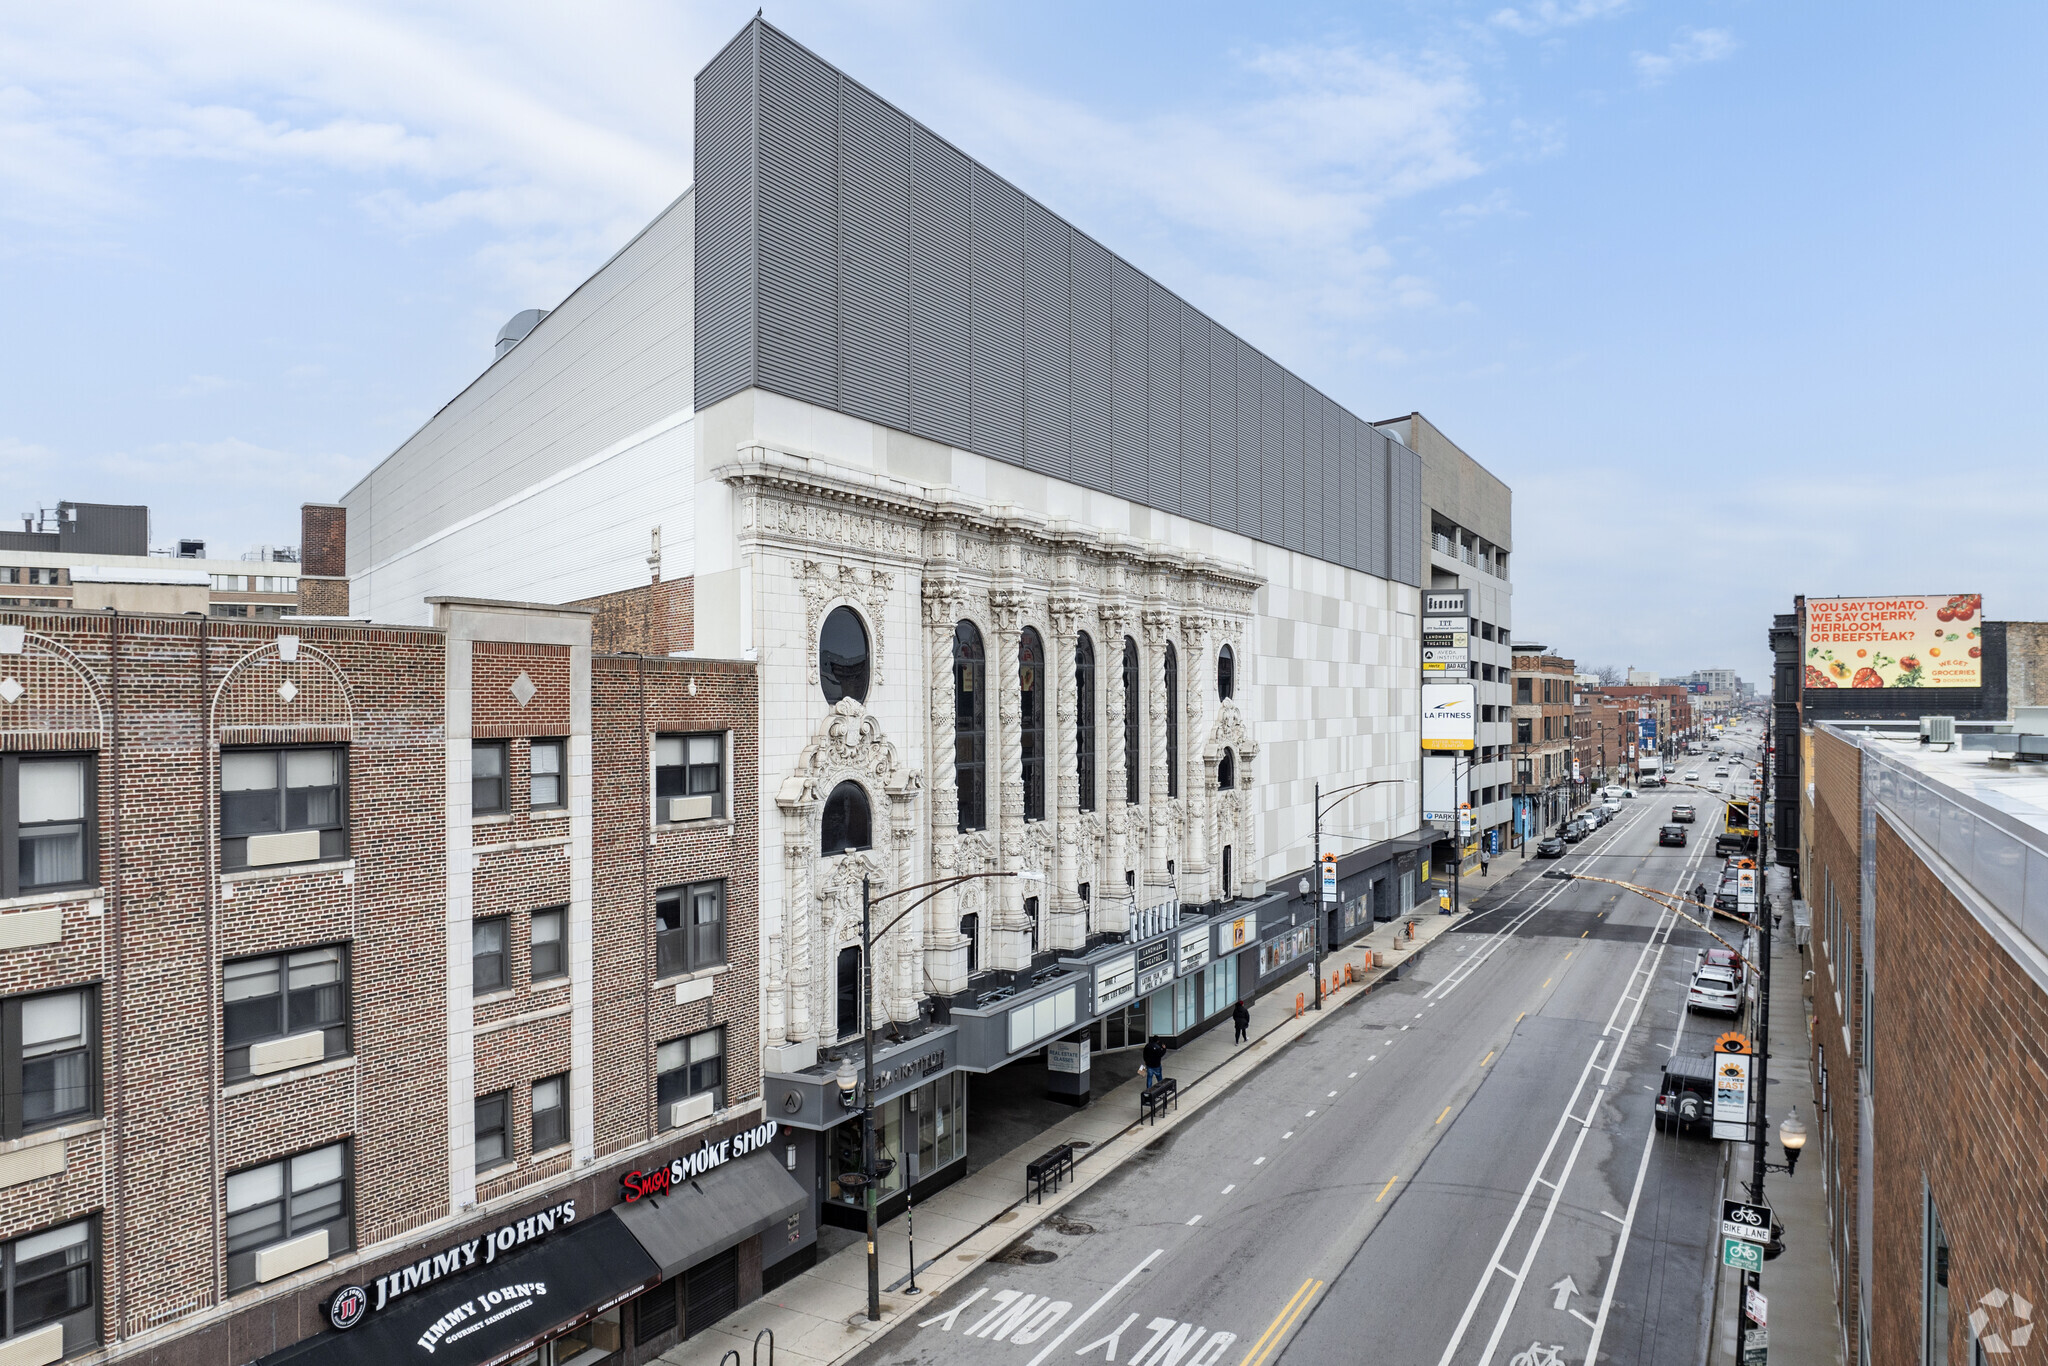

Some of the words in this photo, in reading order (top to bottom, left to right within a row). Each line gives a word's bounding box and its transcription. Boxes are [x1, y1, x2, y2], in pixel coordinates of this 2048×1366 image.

[1811, 602, 1841, 613] YOU
[1841, 602, 1867, 612] SAY
[1866, 600, 1929, 611] TOMATO.
[1811, 613, 1833, 623] WE
[1835, 612, 1859, 622] SAY
[1860, 611, 1917, 622] CHERRY,
[1811, 622, 1885, 633] HEIRLOOM,
[1811, 633, 1831, 643] OR
[1832, 631, 1916, 642] BEEFSTEAK?
[1938, 660, 1952, 668] WE
[1953, 659, 1968, 667] GET
[1718, 1081, 1744, 1090] EAST
[671, 1139, 730, 1185] SMOKE
[733, 1120, 778, 1158] SHOP
[1723, 1223, 1742, 1234] BIKE
[1745, 1228, 1768, 1240] LANE
[374, 1239, 480, 1311] JIMMY
[484, 1200, 576, 1264] JOHN'S
[416, 1299, 477, 1354] JIMMY
[477, 1282, 547, 1312] JOHN'S
[445, 1323, 485, 1345] GOURMET
[484, 1299, 533, 1327] SANDWICHES
[918, 1287, 1073, 1346] ONLY
[1075, 1313, 1238, 1366] ONLY
